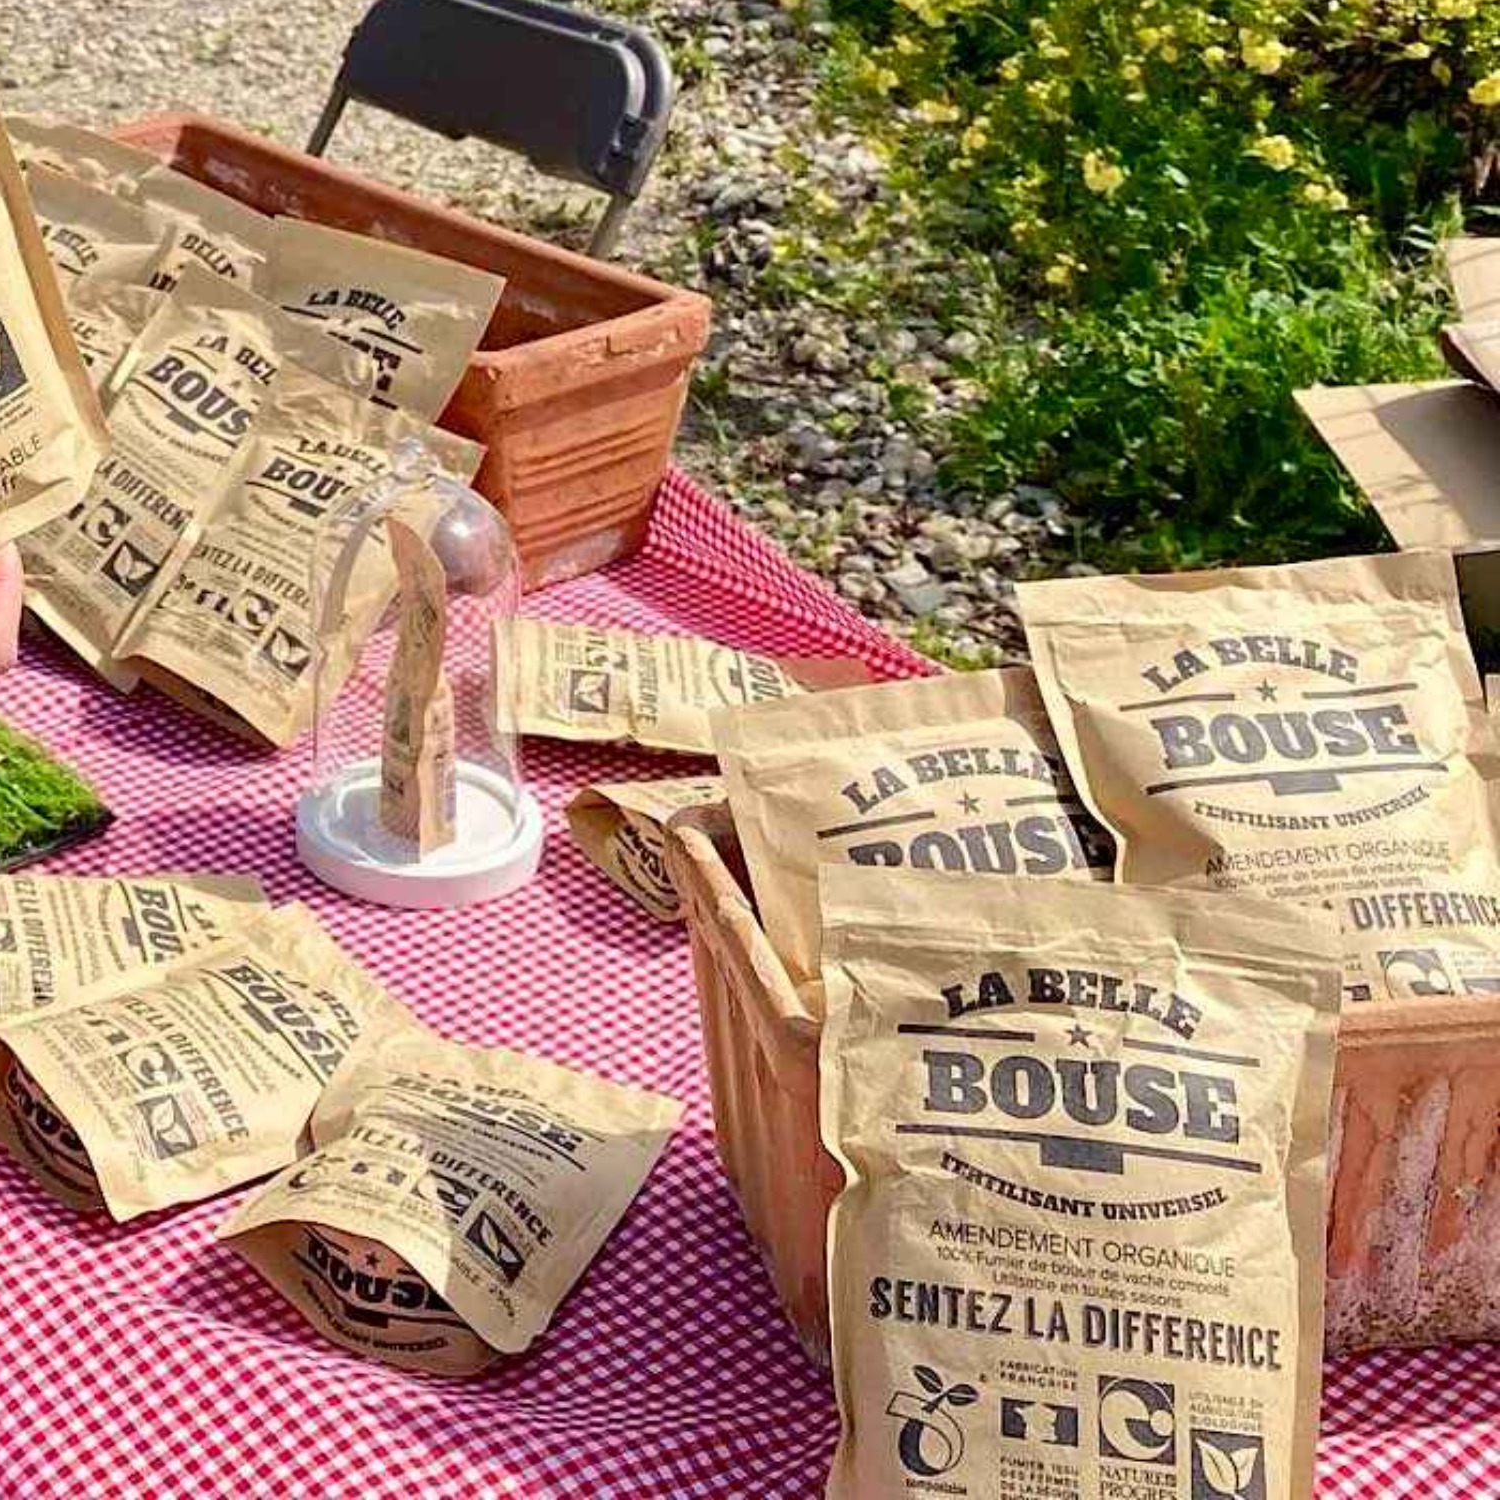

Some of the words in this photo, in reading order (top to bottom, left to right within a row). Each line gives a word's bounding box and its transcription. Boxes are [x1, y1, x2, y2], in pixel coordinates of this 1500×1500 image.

[145, 353, 251, 436] BOUS
[110, 468, 194, 530] DIFFEREN
[1142, 650, 1209, 693] LA
[1208, 635, 1358, 684] BELLE
[1151, 704, 1422, 769] BOUSE
[841, 765, 909, 815] LA
[906, 747, 1062, 787] BELLE
[1193, 800, 1331, 831] FERTILISANT
[1206, 845, 1340, 876] AMENDEMENT
[941, 972, 1015, 1018] LA
[1027, 967, 1204, 1040] BELLE
[166, 1031, 249, 1142] DIFFERENCE
[923, 1049, 1239, 1144] BOUSE
[430, 1151, 554, 1247] DIFFERENCE
[940, 1152, 1097, 1217] FERTILISANT
[1102, 1186, 1230, 1221] UNIVERSEL
[930, 1220, 1095, 1259] AMENDEMENT
[1102, 1242, 1235, 1278] ORGANIQUE
[977, 1253, 1024, 1271] Fumier
[1028, 1258, 1047, 1272] de
[1124, 1269, 1165, 1286] vache
[1060, 1281, 1079, 1294] en
[869, 1276, 1012, 1334] SENTEZ
[1023, 1298, 1070, 1343] LA
[1081, 1304, 1283, 1371] DIFFERENCE
[999, 1359, 1078, 1378] FABRICATION
